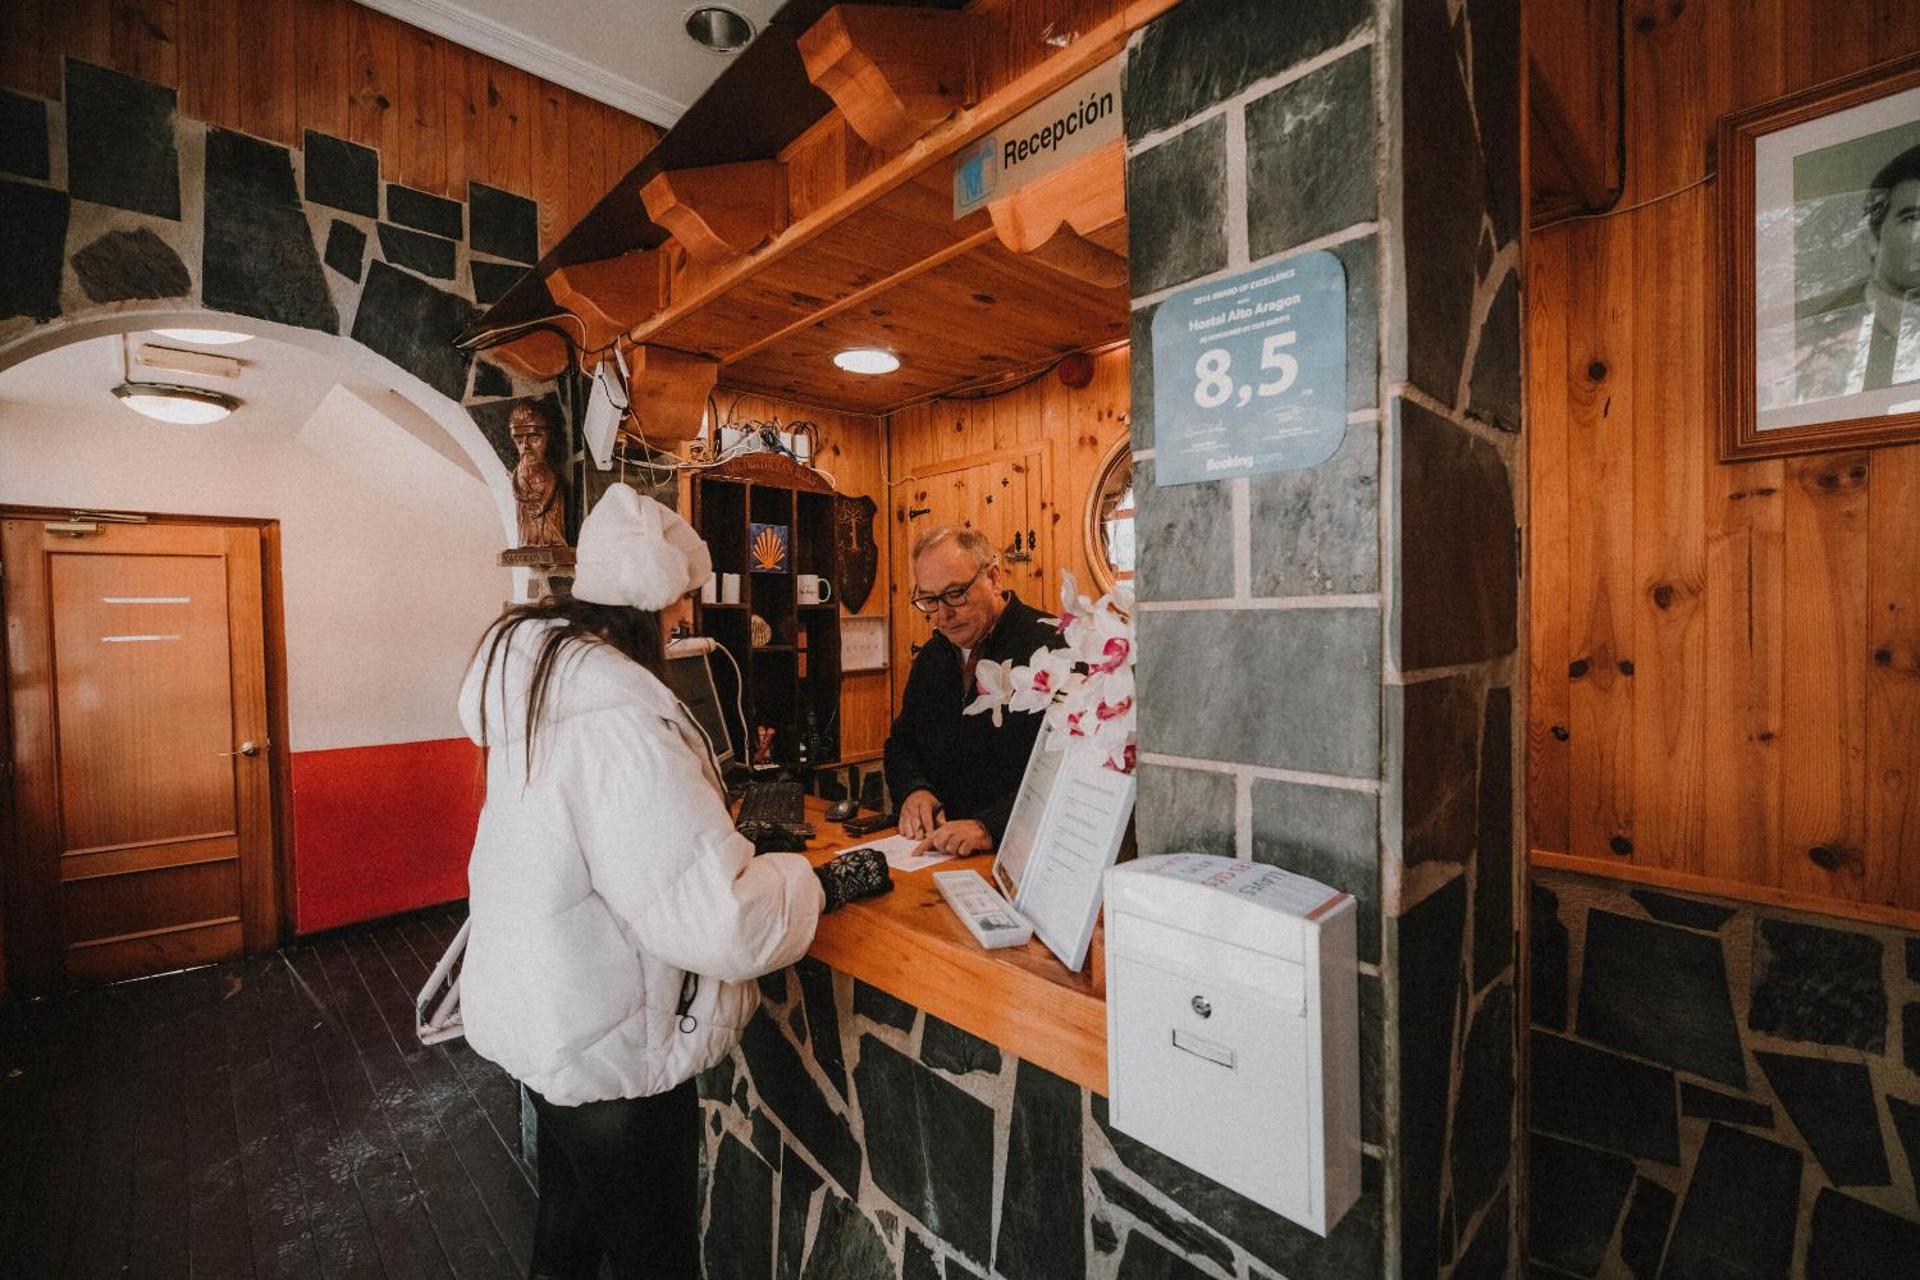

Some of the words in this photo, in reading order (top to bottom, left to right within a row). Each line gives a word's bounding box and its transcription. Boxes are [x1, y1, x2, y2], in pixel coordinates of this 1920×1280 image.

[1004, 92, 1113, 169] Recepción
[1188, 311, 1226, 333] Hostal
[1227, 308, 1253, 323] Alto
[1194, 330, 1298, 408] 8,5
